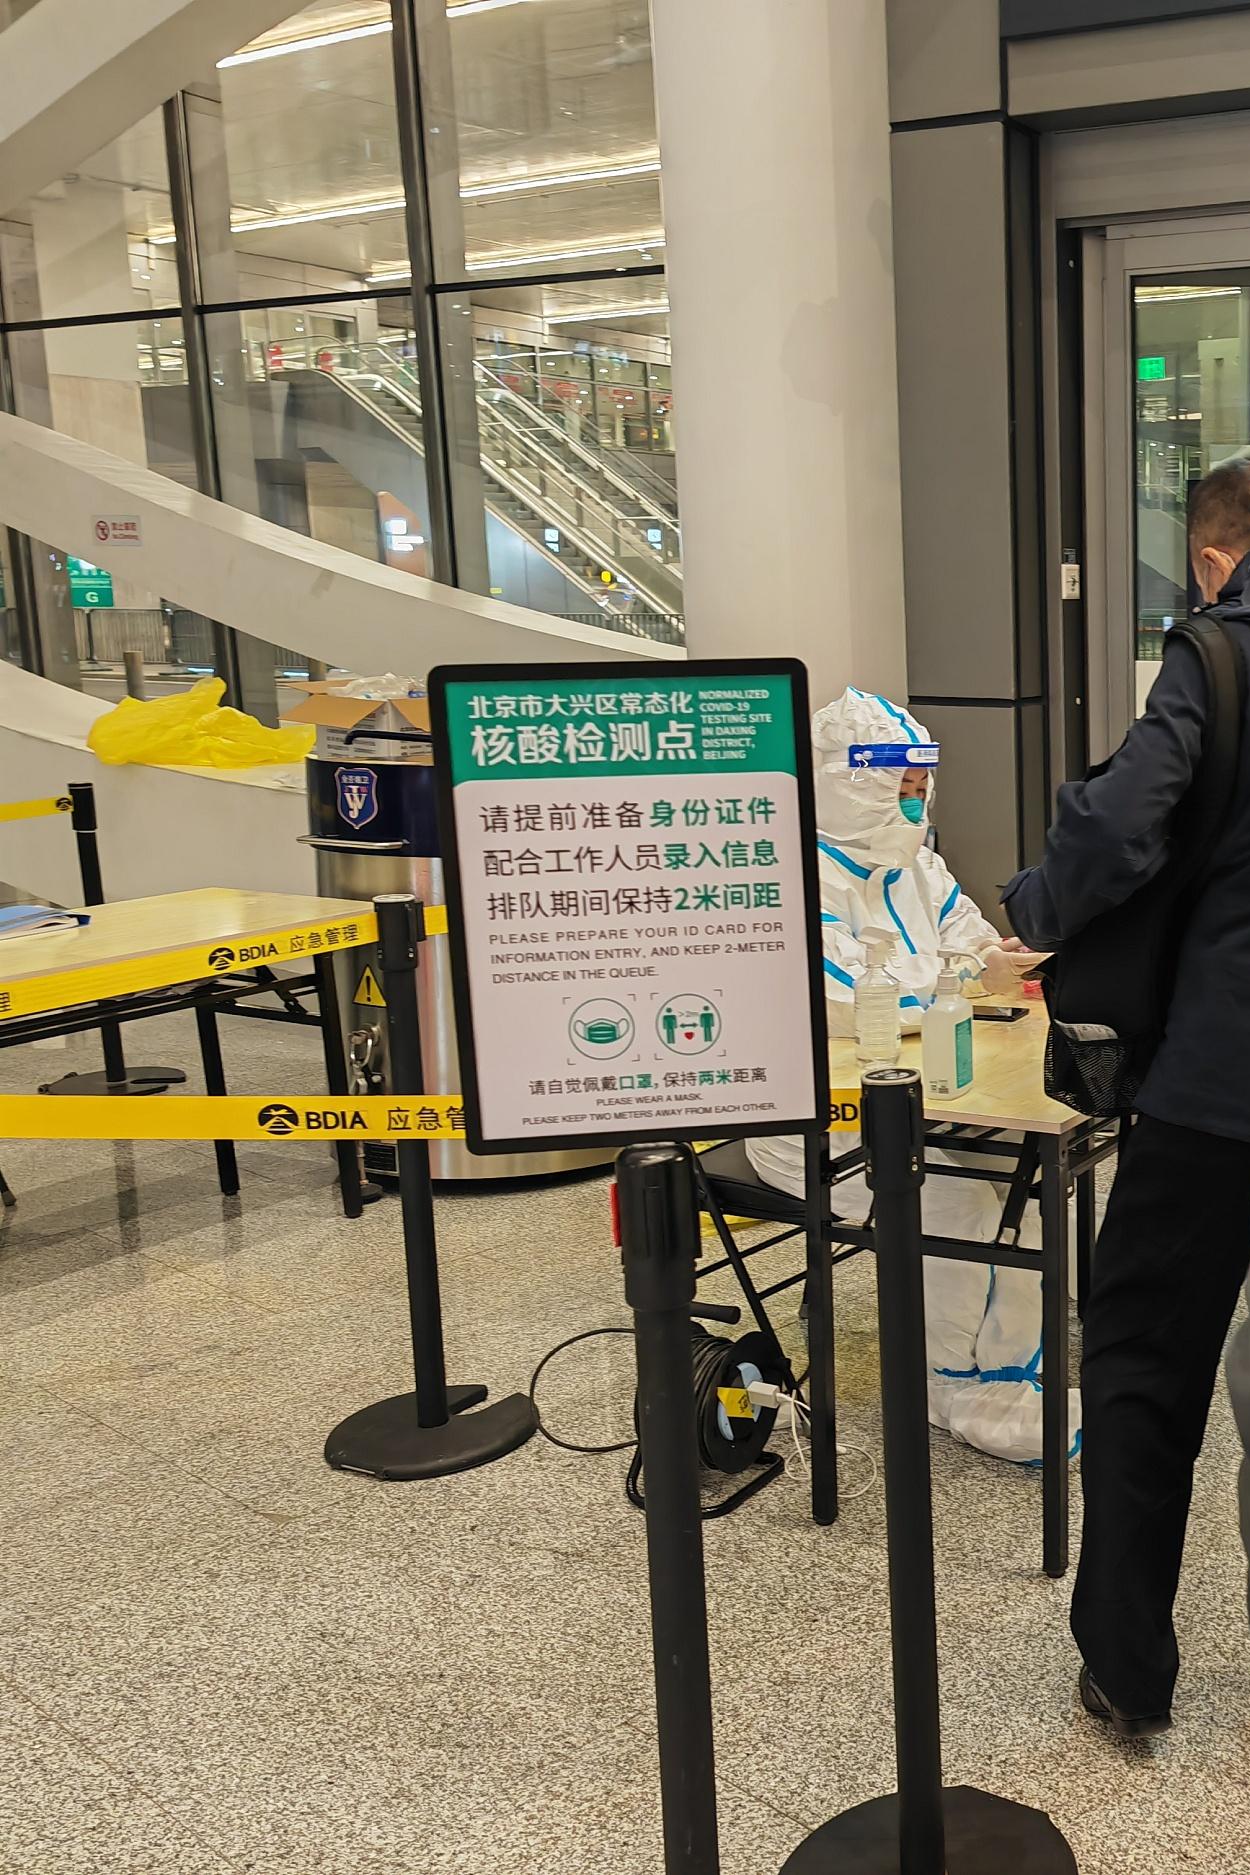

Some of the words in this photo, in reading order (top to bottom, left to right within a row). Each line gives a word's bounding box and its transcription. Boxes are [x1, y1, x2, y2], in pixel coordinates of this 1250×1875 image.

[85, 591, 99, 603] G
[698, 689, 770, 700] NORMALIZED
[467, 691, 694, 719] 北京市大兴区常态化
[699, 701, 751, 712] COVID-19
[700, 714, 747, 724] TESTING
[748, 713, 773, 723] SITE
[701, 727, 714, 736] IN
[715, 725, 757, 735] DAXING
[470, 719, 698, 767] 核酸检测点
[703, 750, 747, 760] BEIJING
[479, 796, 777, 834] 请提前准备身份证件
[482, 838, 780, 878] 配合工作人员录入信息
[486, 882, 783, 921] 排队期间保持2米间距
[239, 942, 279, 962] BDIA
[289, 923, 360, 953] 应急管理
[489, 932, 550, 945] PLEASE
[555, 928, 630, 942] PREPARE
[634, 926, 678, 938] YOUR
[683, 925, 699, 936] ID
[704, 923, 747, 936] CARD
[752, 921, 784, 933] FOR
[490, 950, 591, 964] INFORMATION
[650, 945, 680, 957] AND
[683, 943, 721, 956] KEEP
[724, 940, 786, 954] 2-METER
[492, 970, 560, 984] DISTANCE
[563, 969, 577, 981] IN
[578, 968, 606, 980] THE
[596, 1096, 634, 1106] PLEASE
[635, 1094, 664, 1104] WEAR
[665, 1094, 673, 1103] A
[305, 1110, 368, 1130] BDIA
[522, 1115, 560, 1125] PLEASE
[561, 1113, 588, 1123] KEEP
[589, 1111, 613, 1121] TWO
[613, 1109, 654, 1120] METERS
[655, 1108, 683, 1118] AWAY
[684, 1105, 713, 1116] FROM
[714, 1104, 741, 1114] EACH
